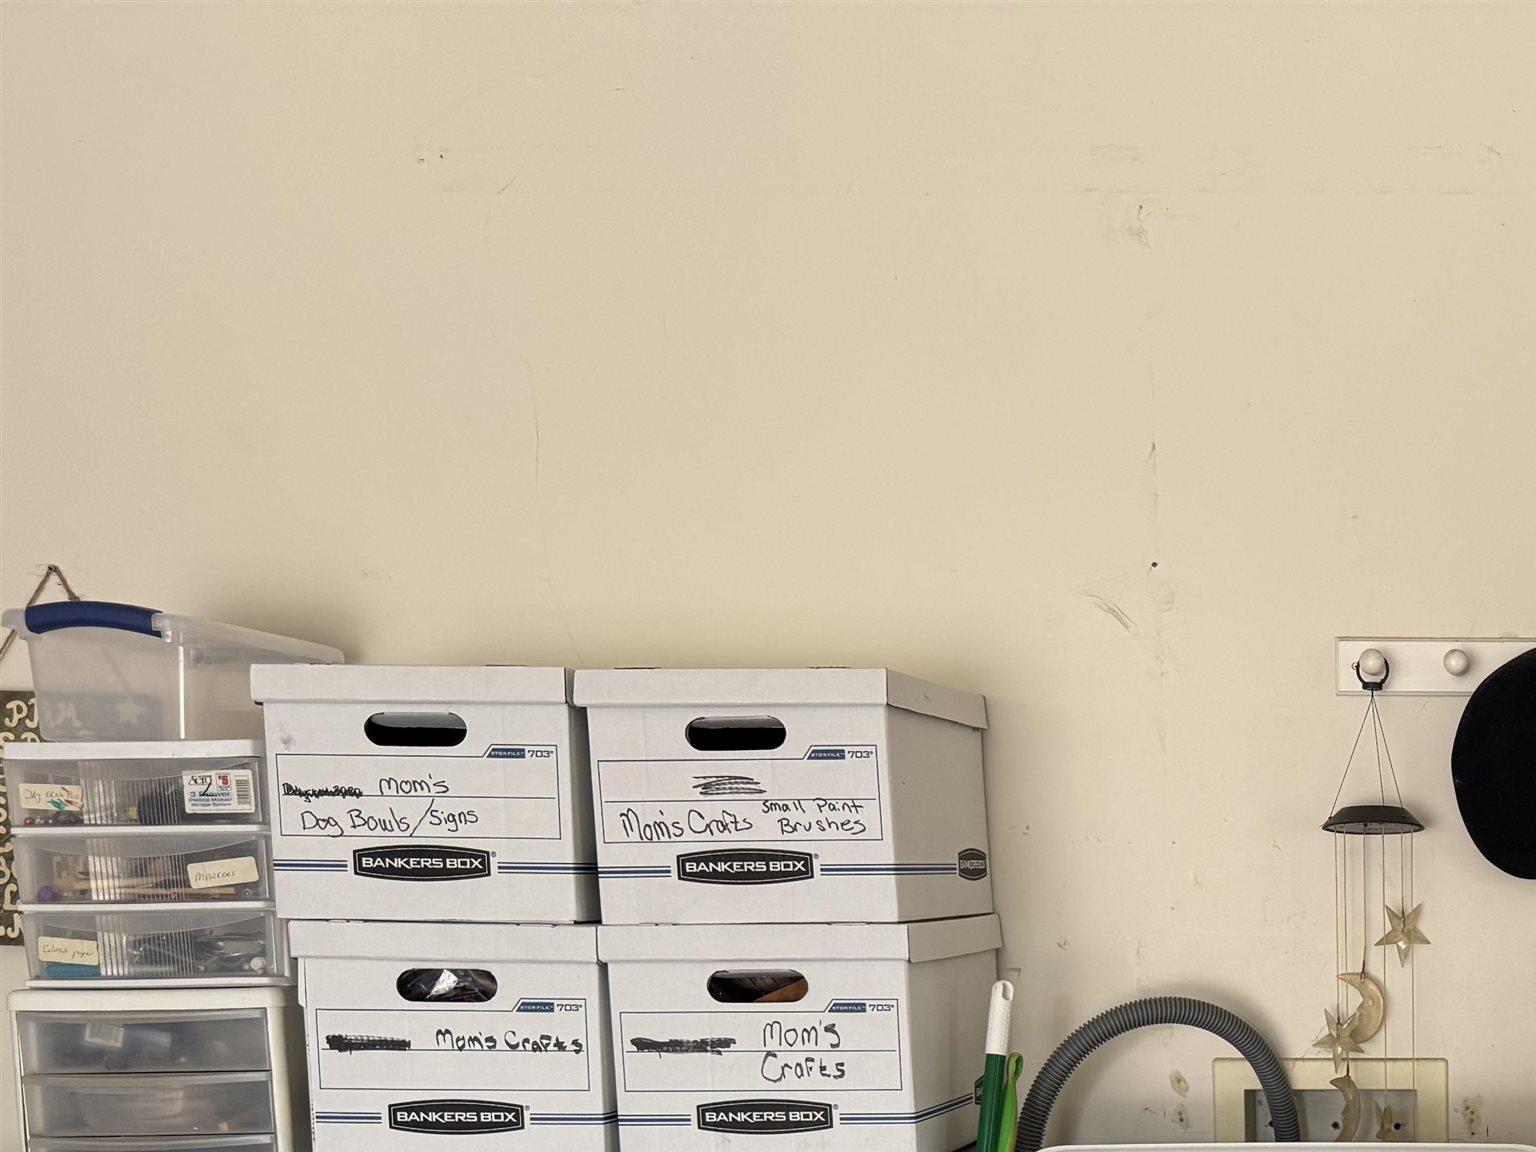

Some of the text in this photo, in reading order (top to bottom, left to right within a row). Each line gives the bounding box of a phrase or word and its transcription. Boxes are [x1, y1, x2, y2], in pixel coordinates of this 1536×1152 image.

[816, 798, 864, 814] Paint
[300, 811, 345, 838] Dog
[619, 806, 754, 842] Mom's Crafts
[777, 817, 867, 836] Brushes
[362, 857, 483, 870] BANKERS BOX
[684, 861, 806, 874] BANKERS BOX
[435, 1028, 497, 1052] Mom's
[762, 1020, 841, 1048] Mom's
[760, 1052, 846, 1083] Crafts
[396, 1111, 517, 1124] BANKERS BOX
[705, 1110, 826, 1124] BANKERS BOX
